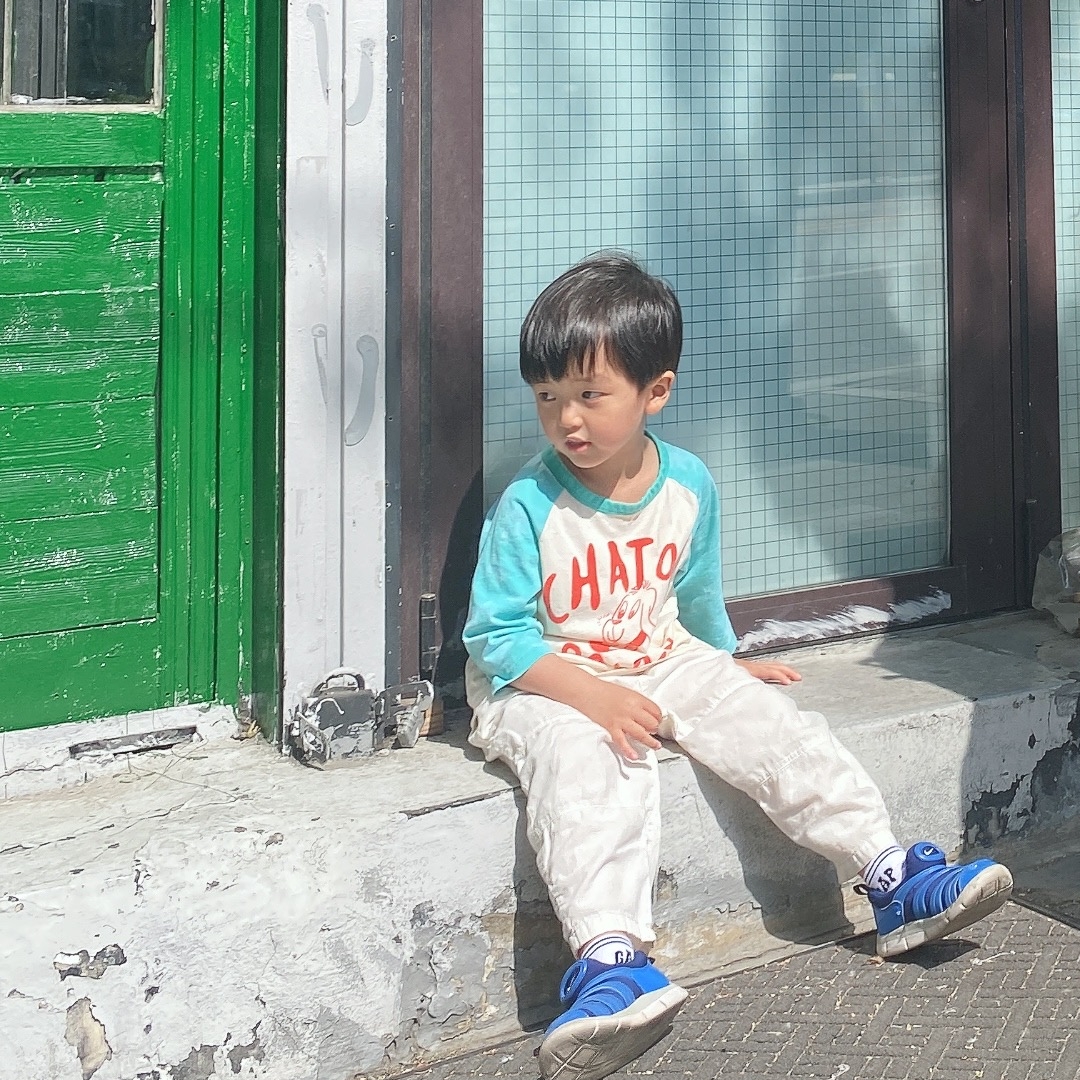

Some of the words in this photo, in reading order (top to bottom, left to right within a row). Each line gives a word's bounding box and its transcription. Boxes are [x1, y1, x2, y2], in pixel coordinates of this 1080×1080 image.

[542, 537, 677, 624] CHATO
[878, 867, 897, 893] AP
[614, 950, 632, 966] GA
